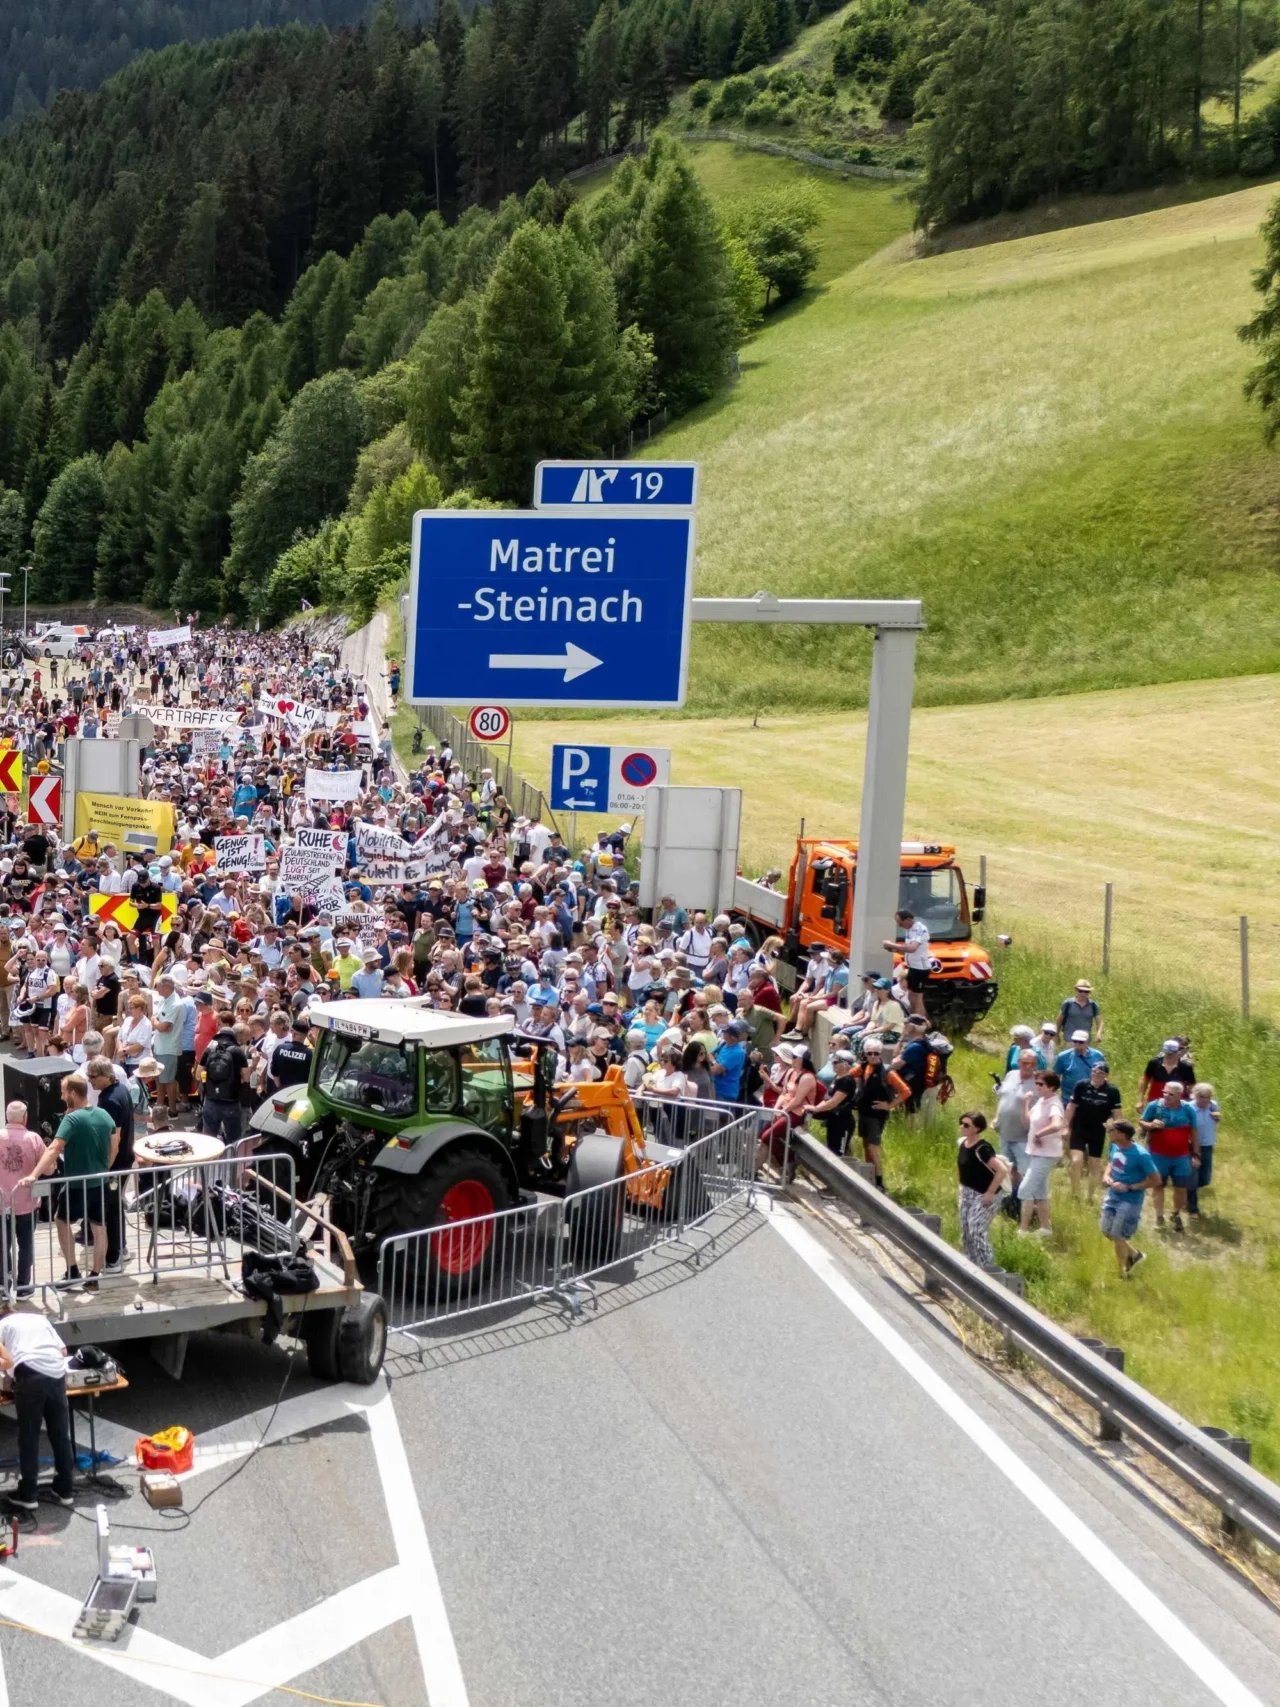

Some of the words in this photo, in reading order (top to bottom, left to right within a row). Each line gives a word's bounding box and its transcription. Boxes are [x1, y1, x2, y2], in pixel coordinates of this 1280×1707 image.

[630, 472, 663, 499] 19
[489, 537, 616, 573] Matrei
[458, 586, 642, 623] -Steinach
[479, 712, 500, 731] 80
[562, 748, 590, 789] P
[126, 806, 154, 814] Verkehr!
[216, 837, 248, 851] GENUG
[297, 830, 333, 847] RUHE
[357, 828, 403, 849] Mobilität
[228, 846, 241, 856] IST
[284, 848, 337, 860] ZULAUFSTRECKEN?
[217, 853, 251, 870] GENUG!
[285, 857, 330, 867] DEUTSCHLAND
[282, 874, 312, 882] JAHREN!
[404, 865, 421, 879] für
[280, 1048, 306, 1060] POLIZEI
